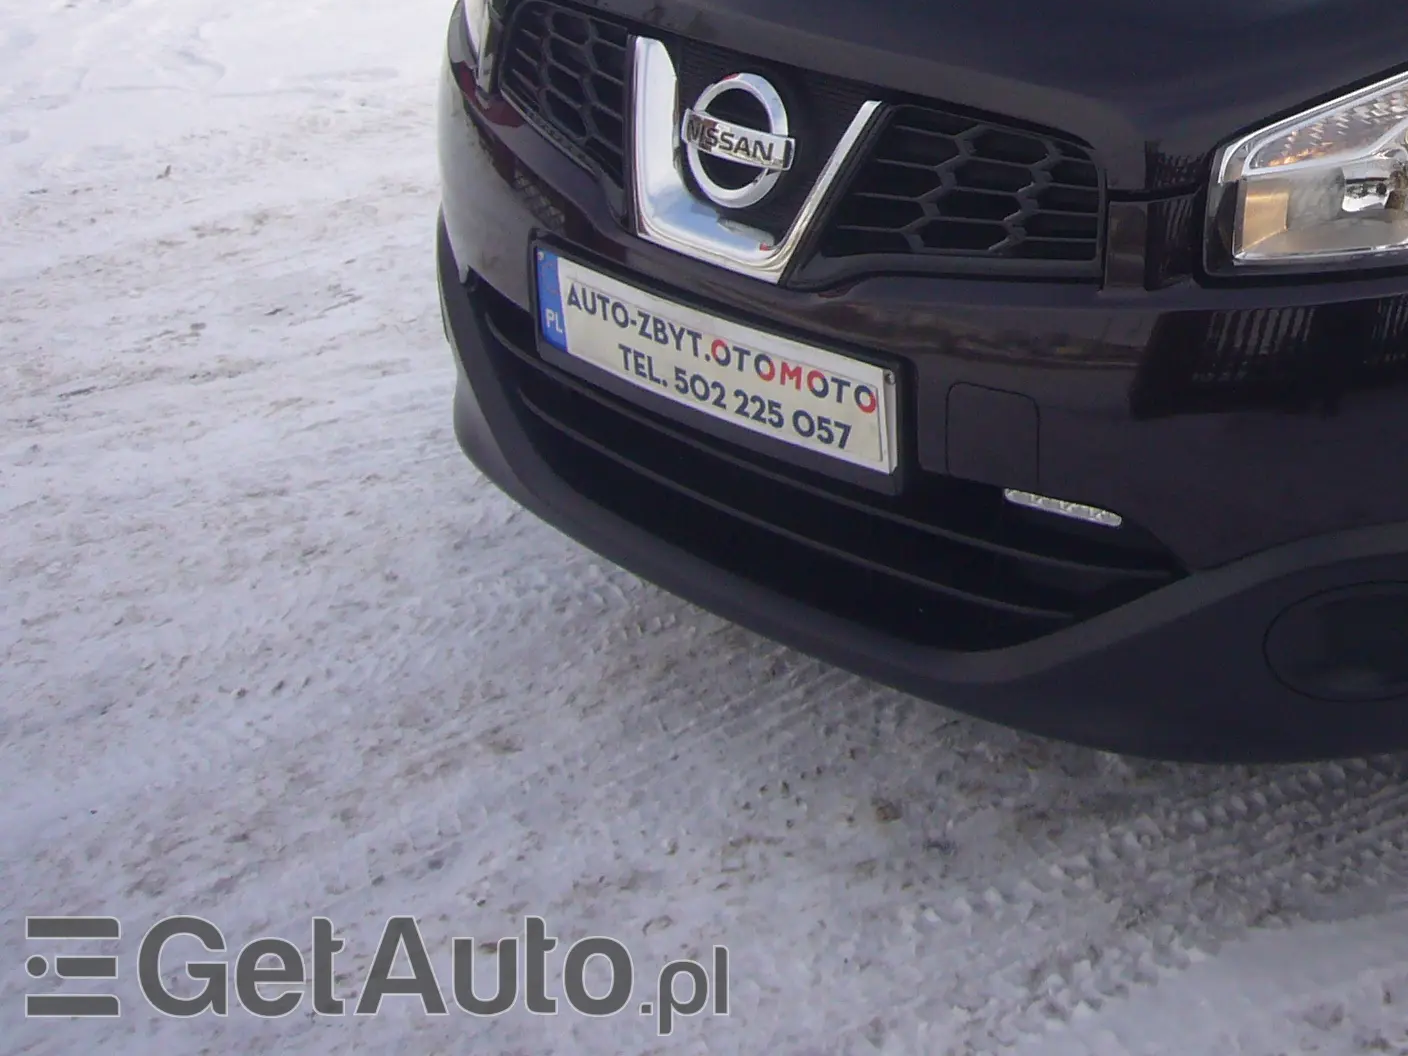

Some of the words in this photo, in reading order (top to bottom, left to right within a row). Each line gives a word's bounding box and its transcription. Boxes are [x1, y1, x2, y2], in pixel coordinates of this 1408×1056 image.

[686, 119, 774, 162] NISSAN
[545, 307, 563, 334] PL
[618, 343, 668, 388] TEL.
[674, 365, 727, 410] 502
[733, 389, 785, 429] 225
[792, 409, 852, 449] 057
